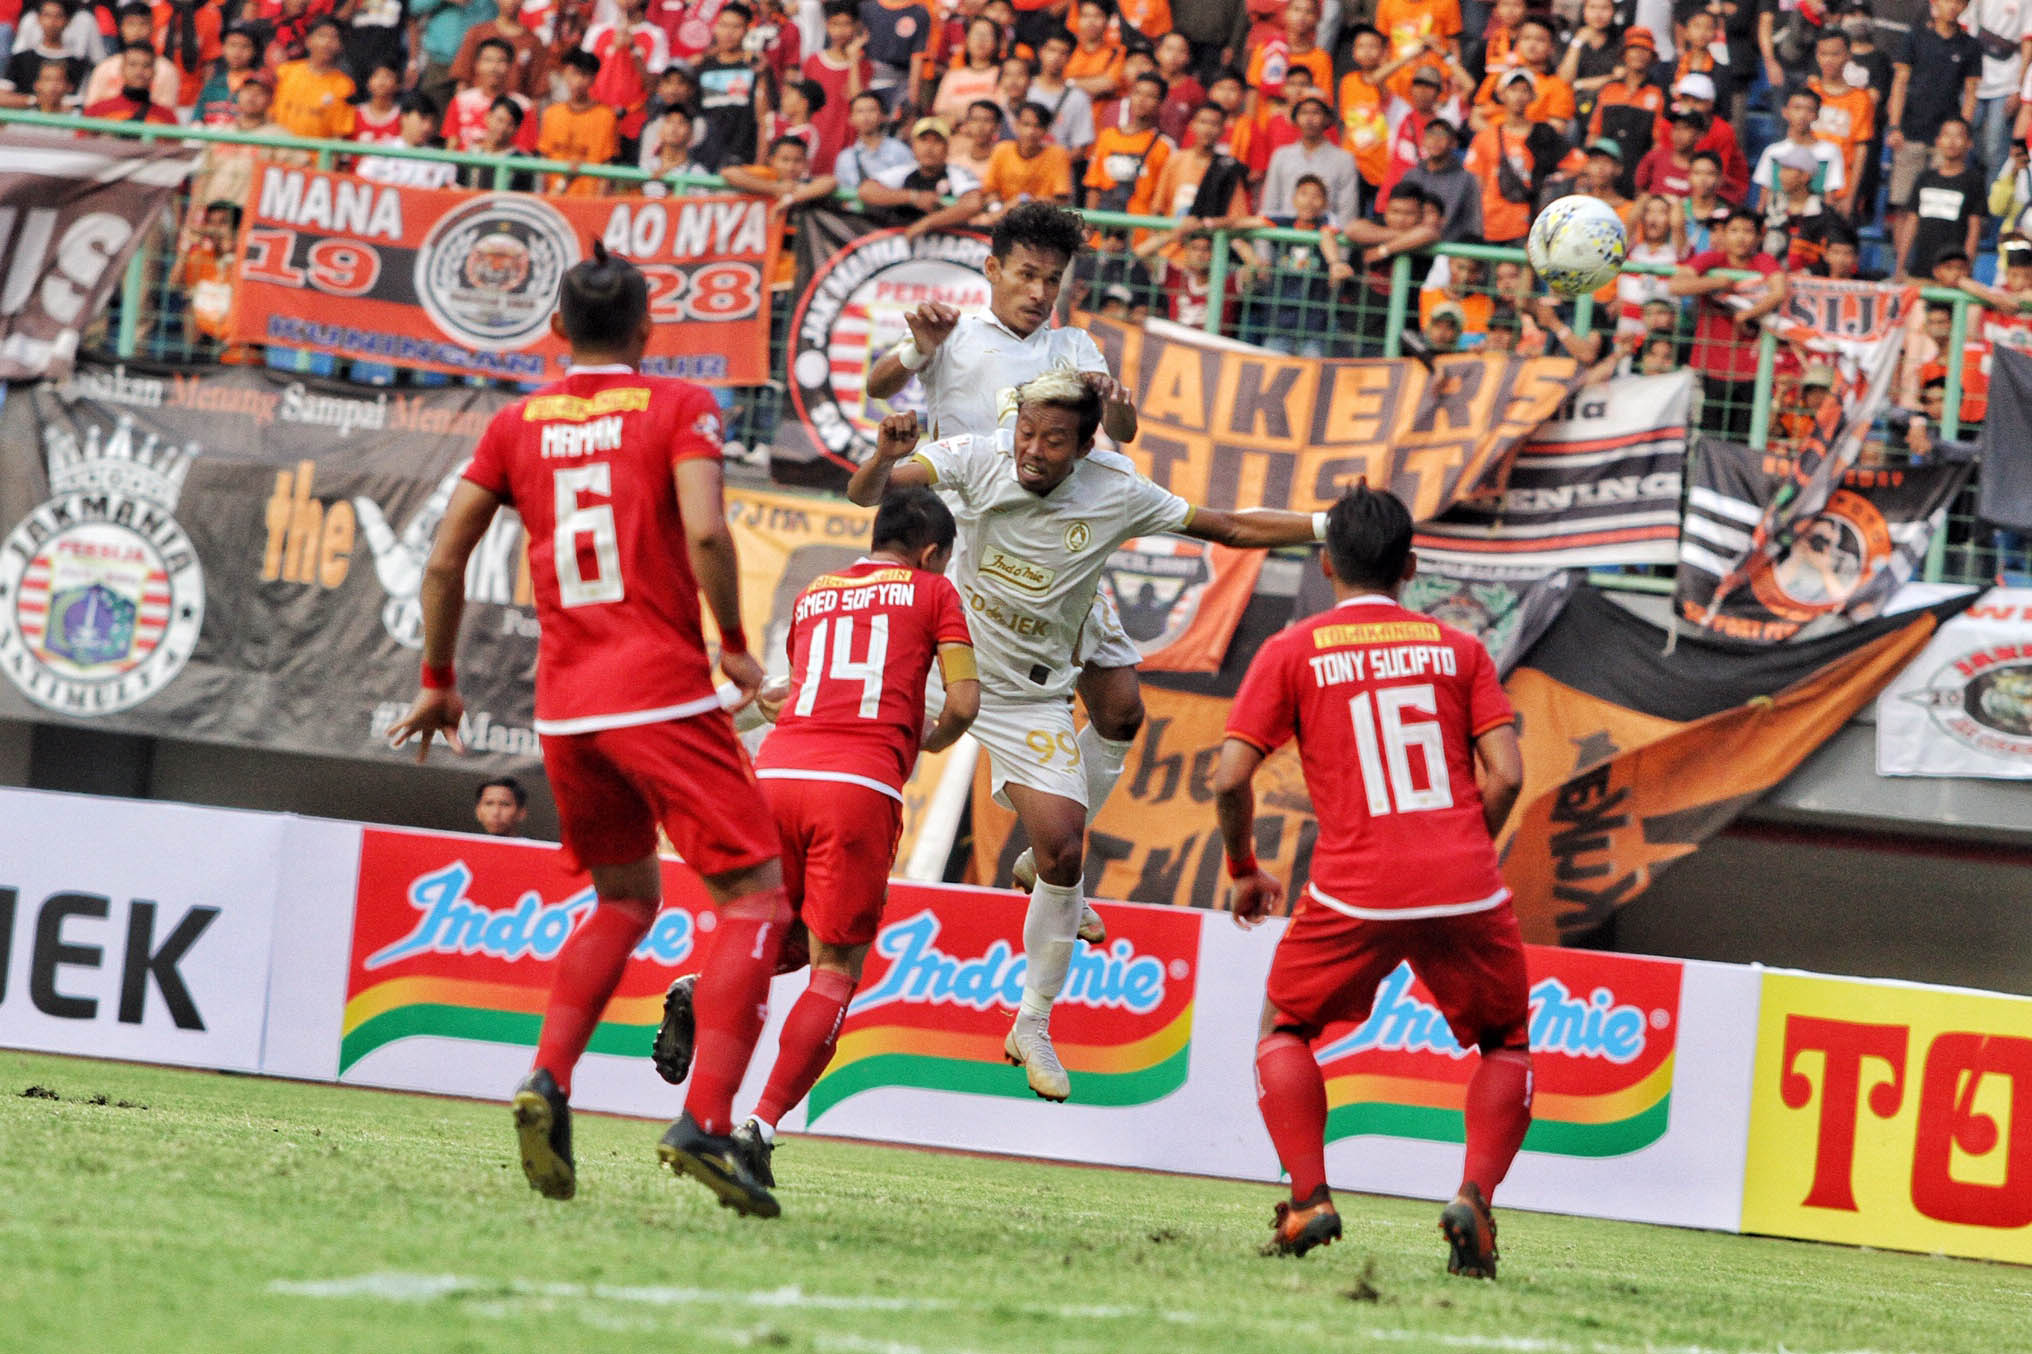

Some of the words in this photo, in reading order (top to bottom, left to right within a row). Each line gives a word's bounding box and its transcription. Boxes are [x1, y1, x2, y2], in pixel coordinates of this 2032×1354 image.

[258, 166, 403, 241] MANA
[673, 200, 767, 258] NYA
[241, 229, 381, 296] 19
[637, 261, 761, 323] 28
[875, 280, 986, 306] PERSIJA
[280, 382, 388, 437] Sampai
[58, 540, 146, 563] PERSIJA
[259, 460, 356, 589] the
[553, 461, 624, 608] 6
[841, 583, 915, 612] SOFYAN
[795, 613, 889, 719] 14
[1308, 649, 1365, 688] TONY
[1368, 645, 1457, 680] SUCIPTO
[1025, 728, 1081, 766] 99
[1348, 683, 1454, 817] 16
